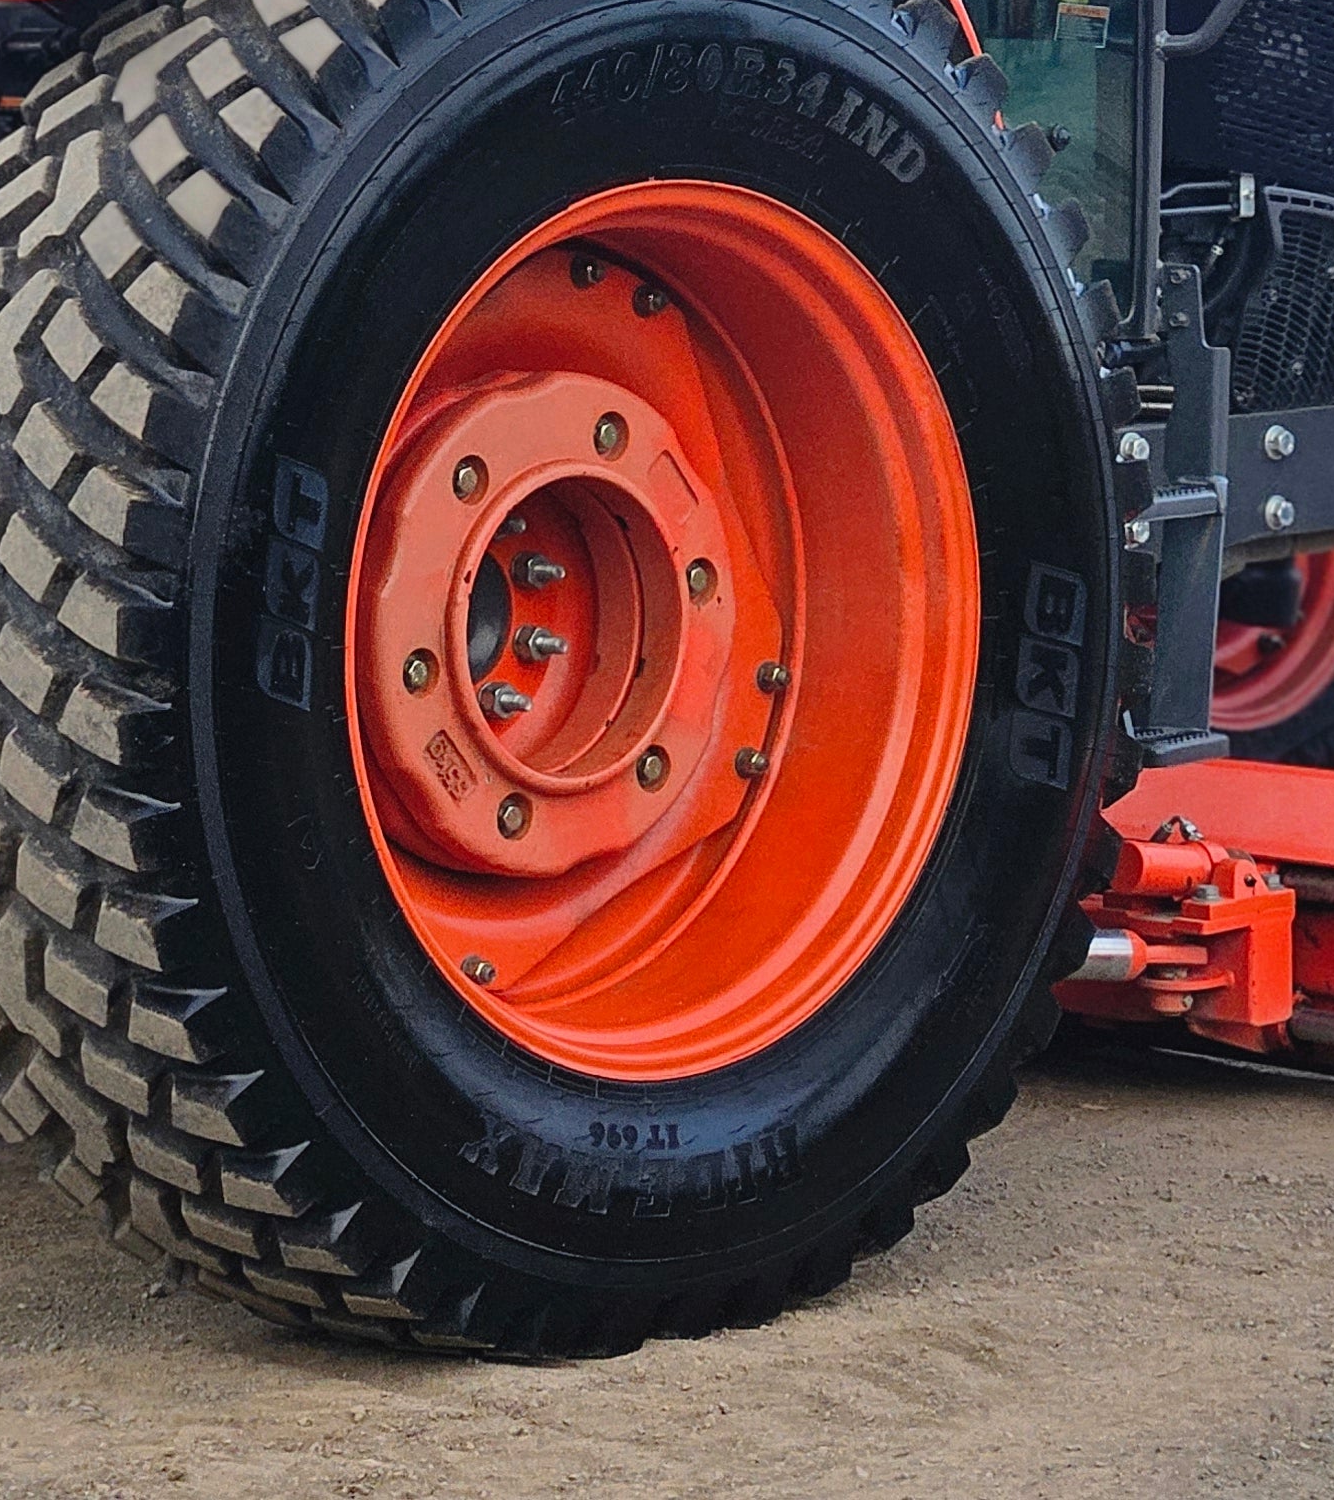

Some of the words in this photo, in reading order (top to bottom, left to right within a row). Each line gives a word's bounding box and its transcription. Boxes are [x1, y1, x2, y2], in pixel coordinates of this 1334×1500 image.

[257, 454, 328, 711] BKT
[1010, 560, 1087, 790] BKT
[587, 1122, 639, 1151] 696
